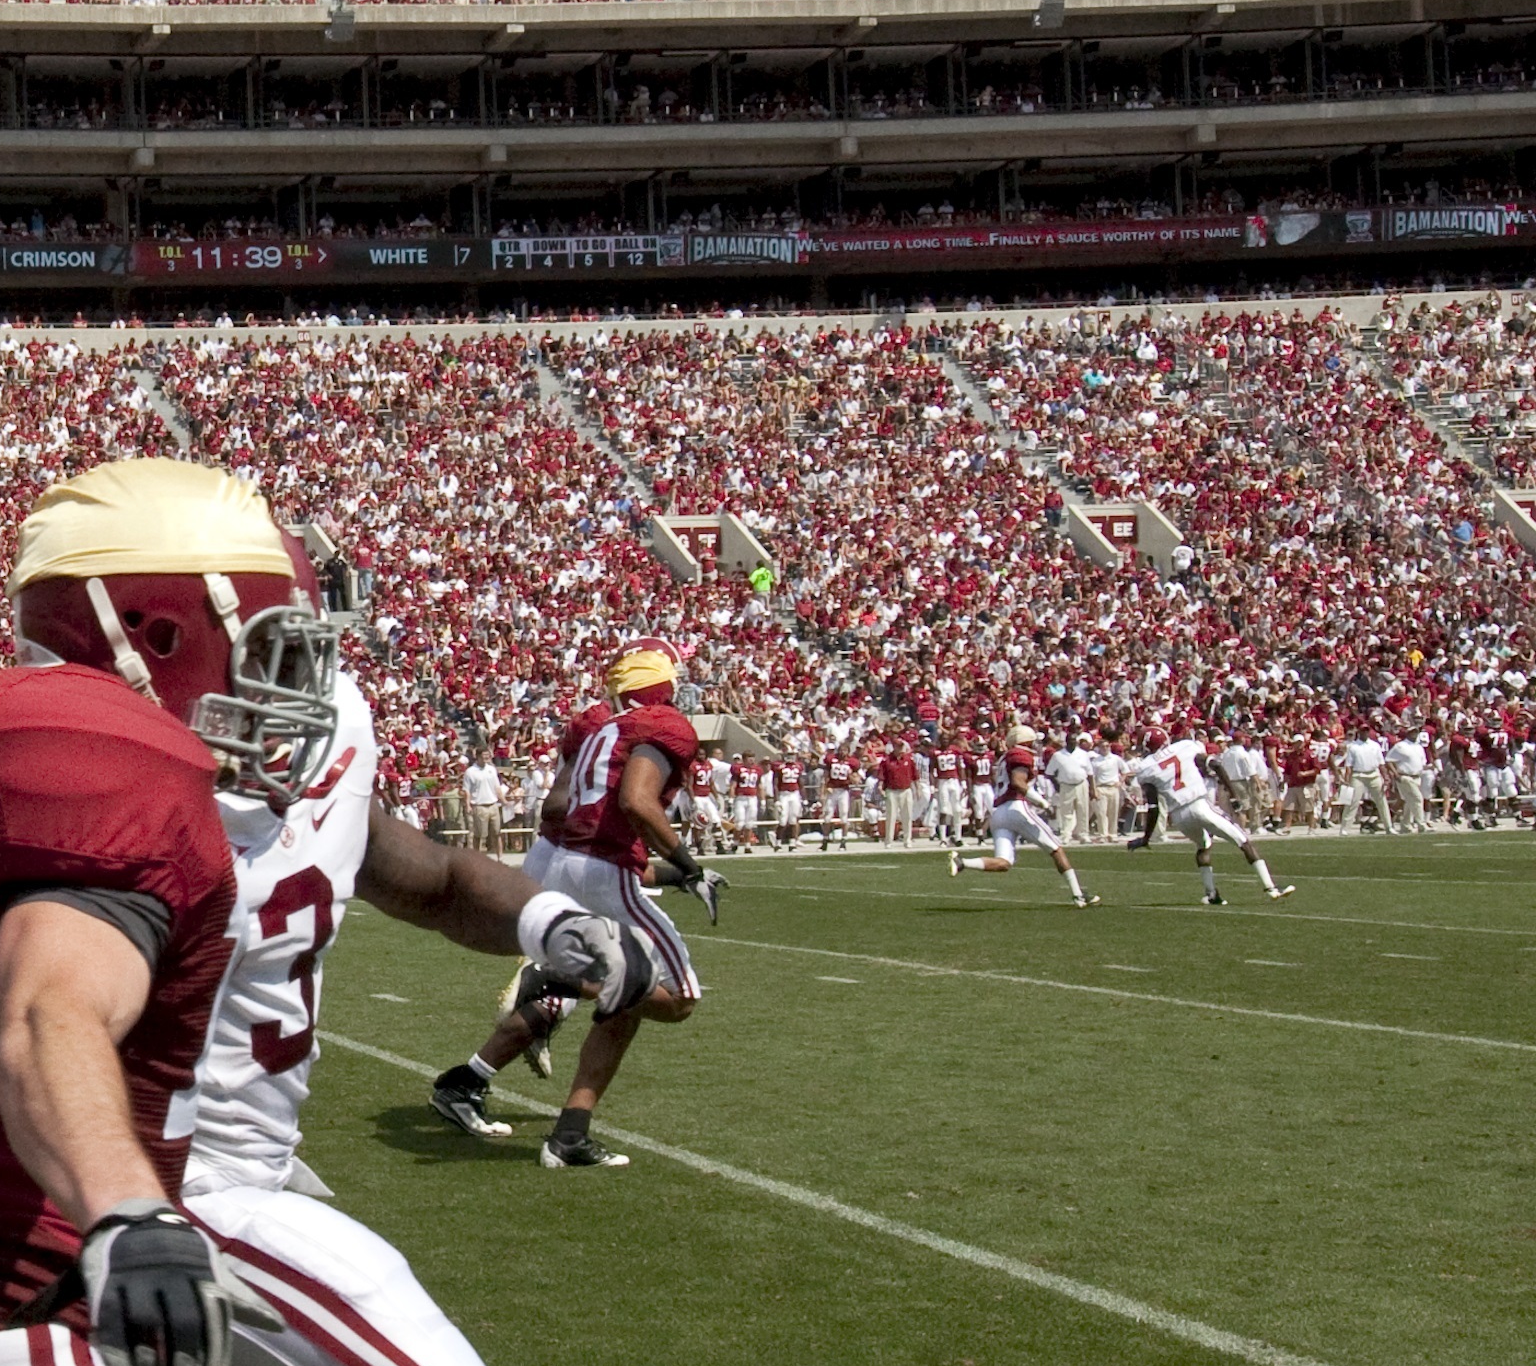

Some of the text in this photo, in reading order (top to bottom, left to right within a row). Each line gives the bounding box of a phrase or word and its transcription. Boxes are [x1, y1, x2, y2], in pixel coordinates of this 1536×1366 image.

[1394, 210, 1499, 236] BAMANATION
[499, 241, 521, 253] QTR
[533, 240, 567, 252] DOWN
[576, 239, 607, 251] TO GO
[614, 237, 657, 250] BALL ON
[842, 239, 889, 252] WAITED
[893, 239, 902, 250] A
[906, 238, 940, 249] LONG
[1045, 234, 1055, 244] A
[1058, 232, 1098, 243] SAUCE
[1102, 230, 1156, 243] WORTHY
[1160, 229, 1176, 241] OF
[1180, 228, 1200, 240] ITS
[1203, 227, 1240, 239] NAME
[369, 248, 428, 264] WHITE
[458, 247, 471, 264] 7
[693, 235, 793, 264] BAMANATION
[10, 251, 96, 268] CRIMSON
[167, 260, 175, 271] 3
[295, 258, 302, 270] 3
[504, 256, 513, 268] 2
[543, 255, 552, 267] 4
[584, 254, 593, 266] 5
[627, 253, 643, 265] 12
[1110, 521, 1131, 537] EE
[1489, 732, 1508, 748] 77
[938, 754, 955, 770] 82
[976, 758, 990, 776] 10
[1158, 754, 1186, 793] 7
